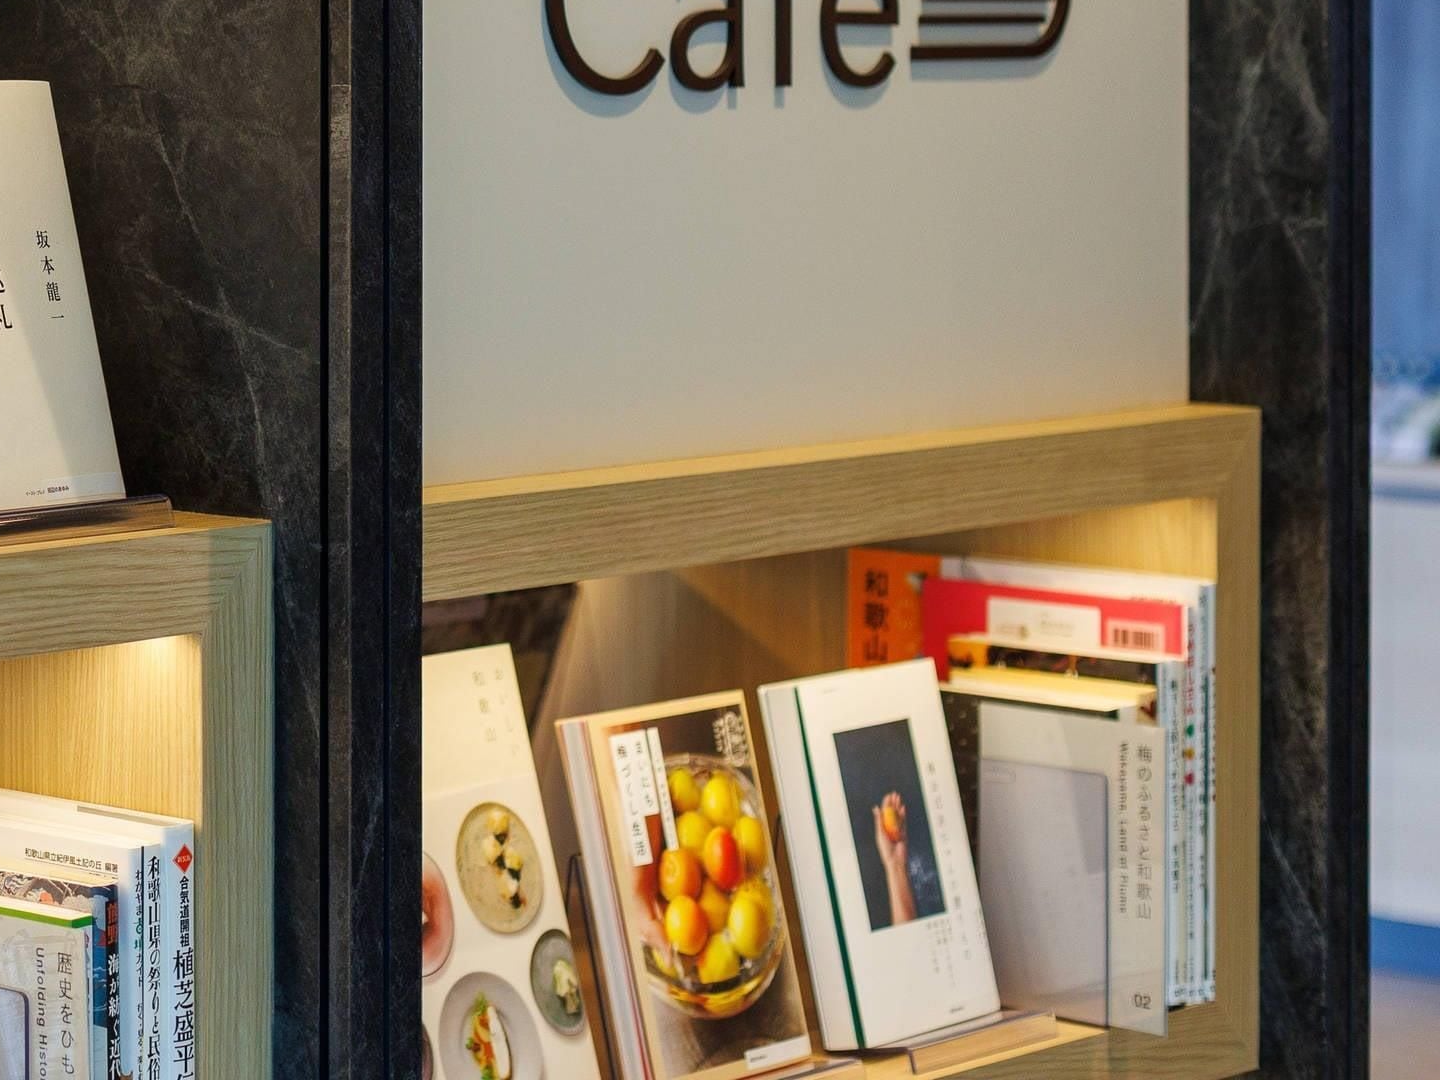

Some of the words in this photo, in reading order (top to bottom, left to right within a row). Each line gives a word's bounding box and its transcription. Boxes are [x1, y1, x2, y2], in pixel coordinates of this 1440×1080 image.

[36, 230, 65, 319] 坂本龍一
[25, 847, 102, 870] 和歌山県立紀伊風土記の丘
[179, 875, 191, 948] 合気道開祖
[35, 948, 47, 1027] Unfolding
[57, 952, 74, 1075] 歴史をひも
[1134, 993, 1152, 1011] 02
